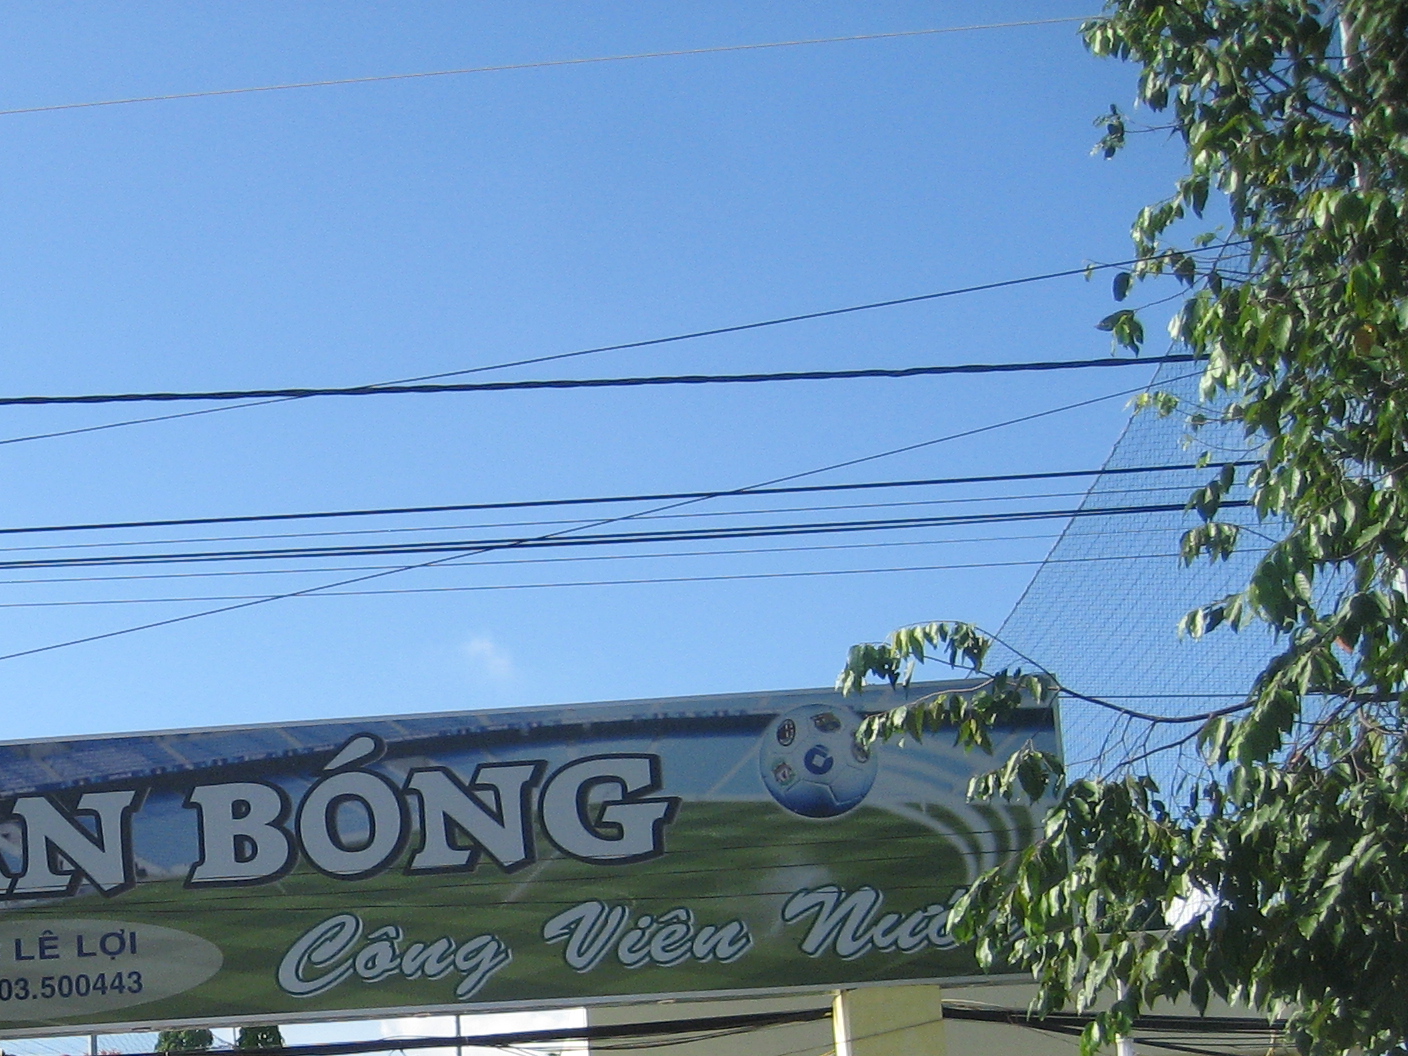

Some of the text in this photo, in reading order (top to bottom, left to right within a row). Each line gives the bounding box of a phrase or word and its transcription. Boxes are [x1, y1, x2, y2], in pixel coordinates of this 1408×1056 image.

[186, 732, 681, 889] BÓNG
[14, 930, 60, 961] LÊ
[76, 929, 138, 961] LỢI
[277, 883, 1025, 999] Công Viên Nướ
